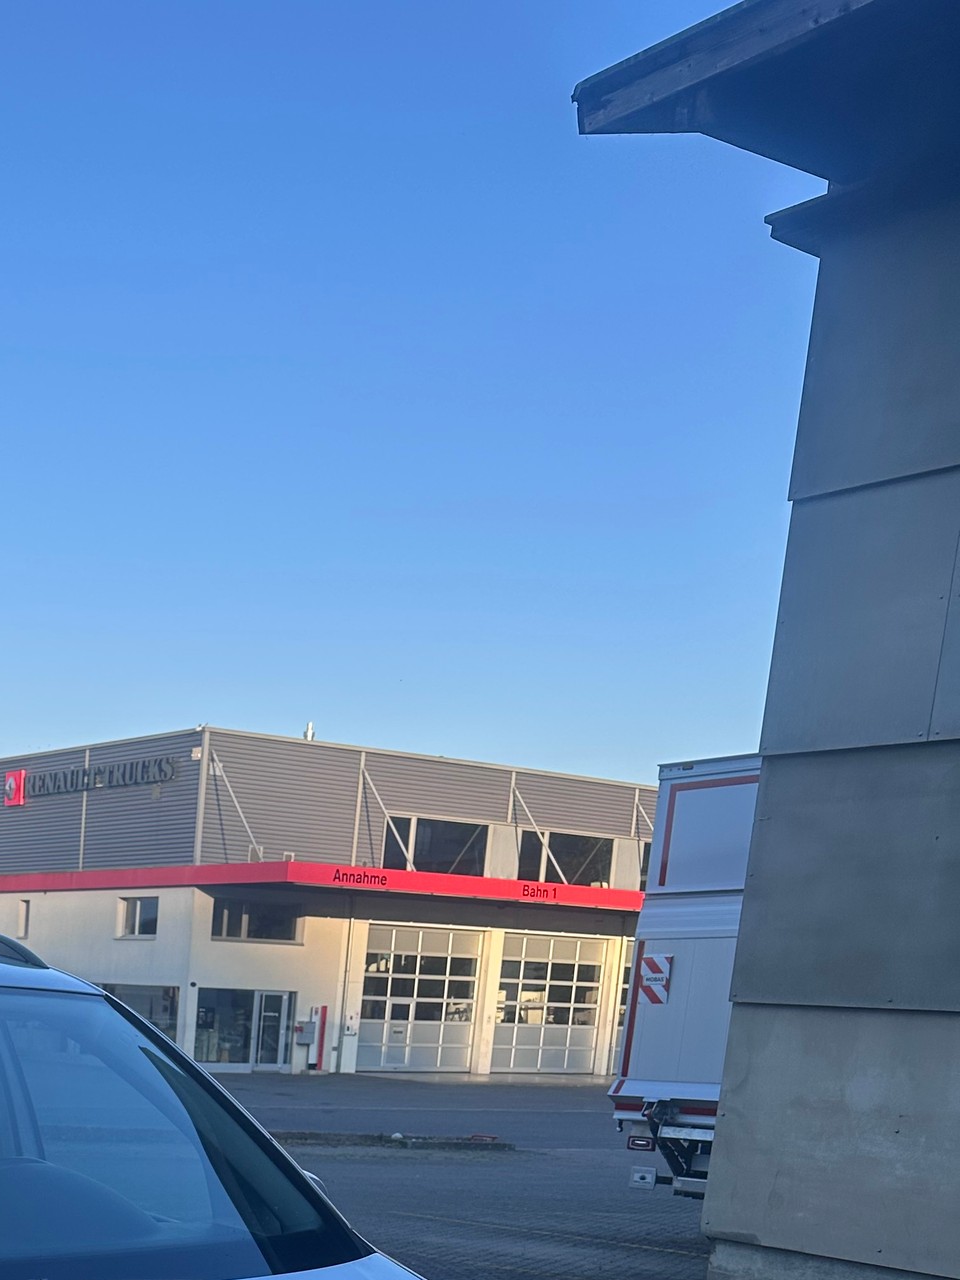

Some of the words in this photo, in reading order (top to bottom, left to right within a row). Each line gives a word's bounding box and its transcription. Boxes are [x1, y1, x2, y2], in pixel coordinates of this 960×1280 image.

[25, 767, 98, 796] RENAULT
[99, 757, 174, 787] TRUCKS
[332, 868, 388, 887] Annahme
[522, 884, 549, 899] Bahn
[552, 887, 558, 899] 1
